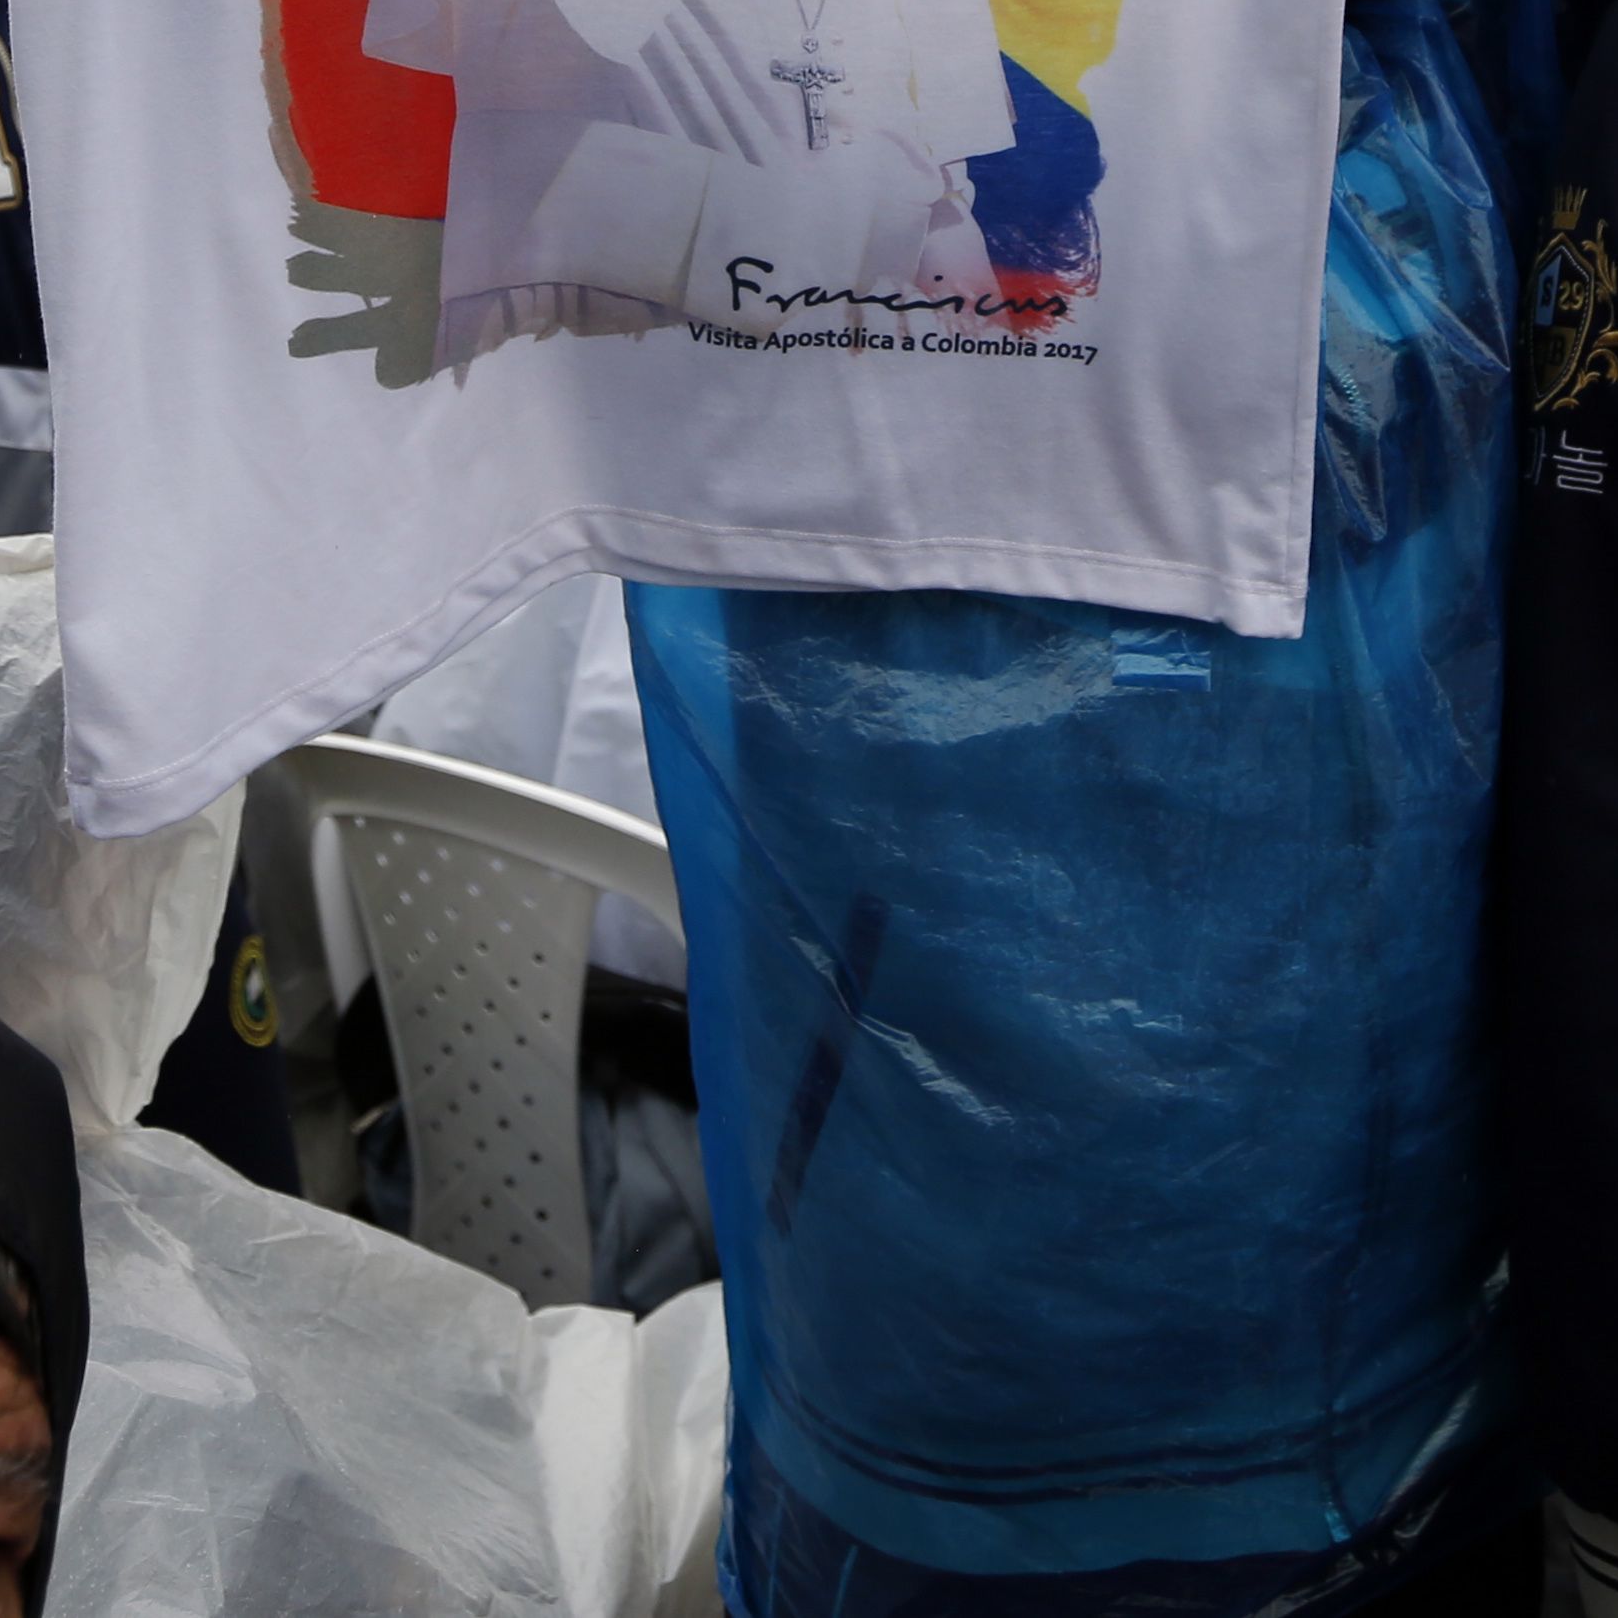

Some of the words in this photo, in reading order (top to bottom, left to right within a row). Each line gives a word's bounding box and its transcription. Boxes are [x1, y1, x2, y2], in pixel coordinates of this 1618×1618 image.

[688, 321, 758, 350] Visita
[763, 327, 894, 354] Apostólica
[902, 337, 915, 352] a
[921, 331, 1038, 358] Colombia
[1044, 342, 1099, 366] 2017
